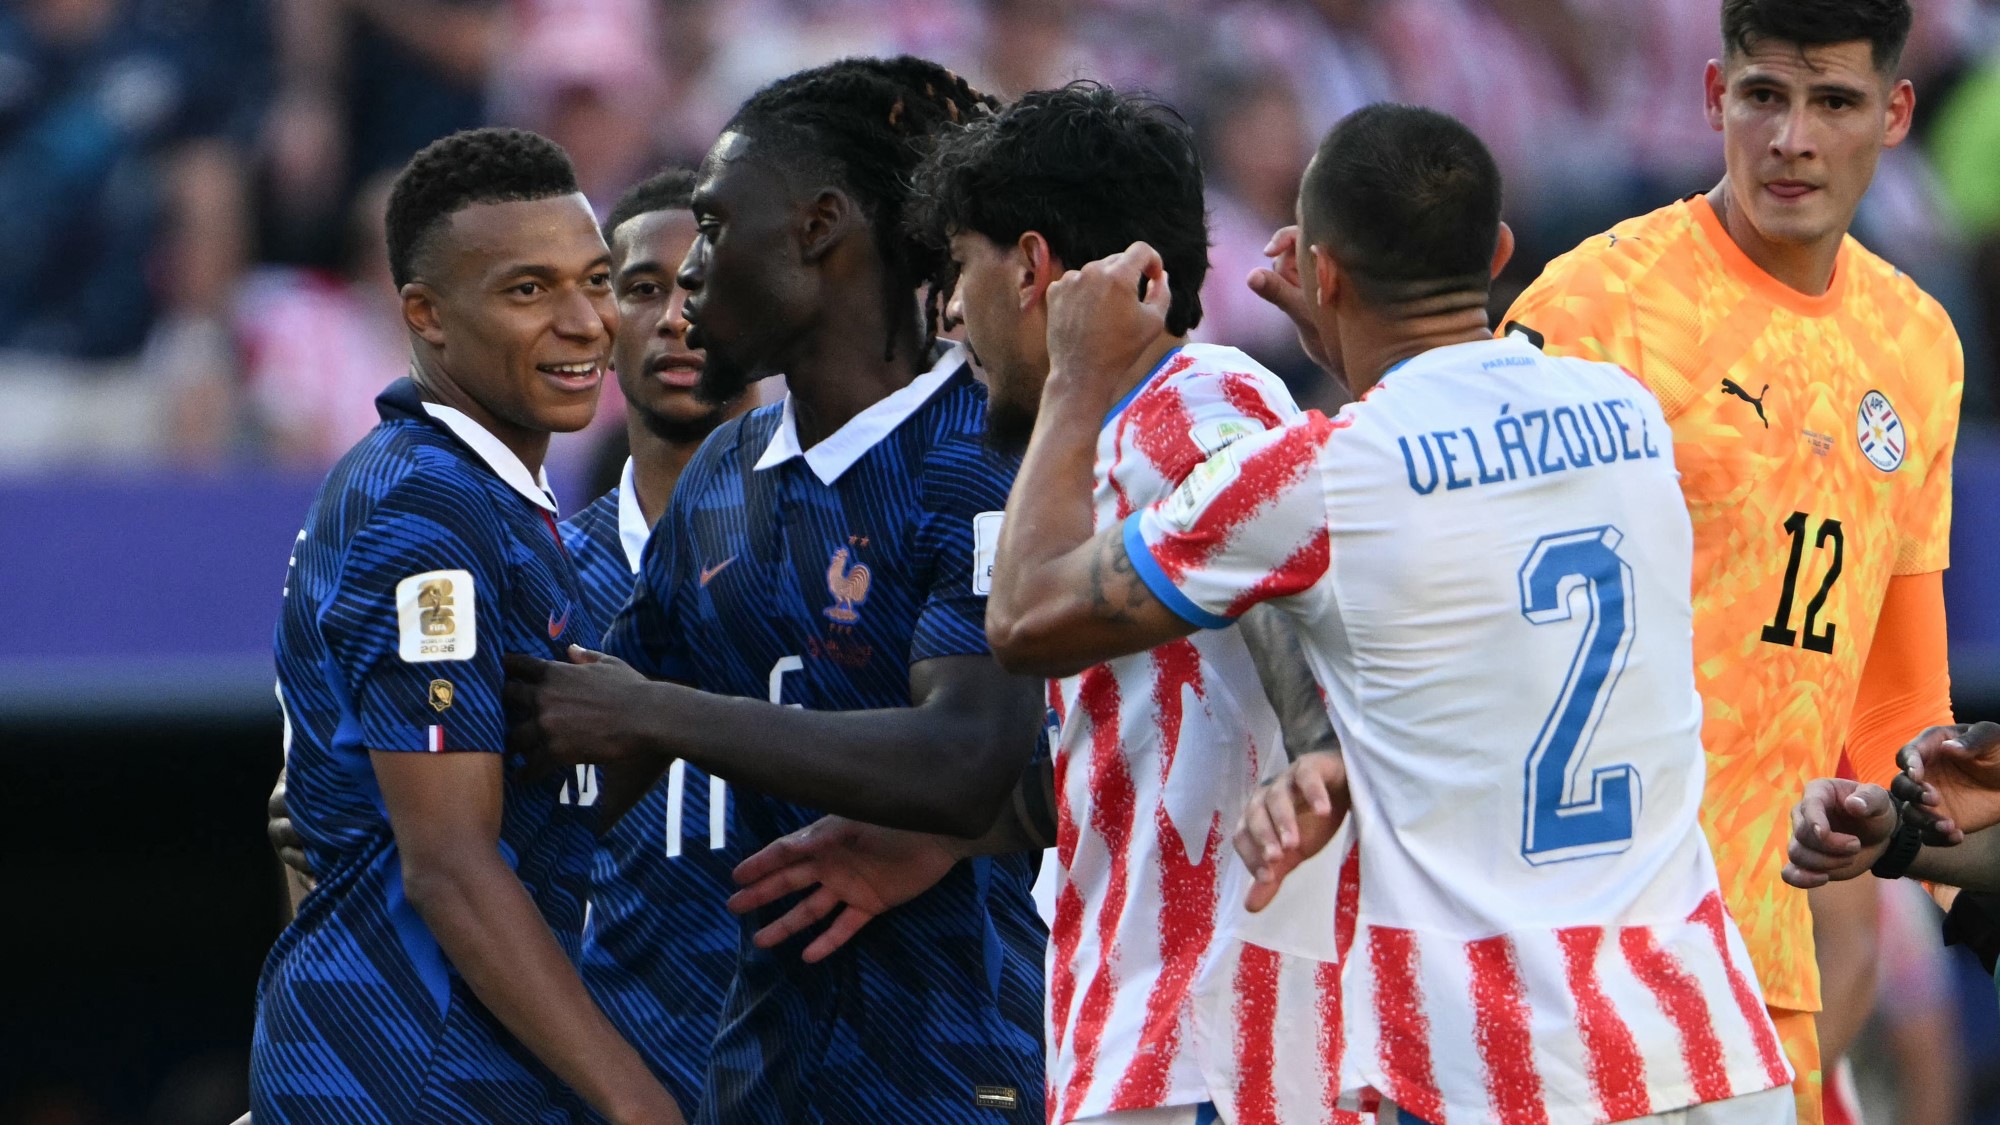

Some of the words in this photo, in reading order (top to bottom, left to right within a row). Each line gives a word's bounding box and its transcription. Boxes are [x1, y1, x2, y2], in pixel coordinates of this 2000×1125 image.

[1870, 397, 1884, 411] APF
[1760, 511, 1844, 654] 12
[429, 623, 447, 632] FIFA
[420, 644, 455, 654] 2026
[1518, 524, 1642, 866] 2
